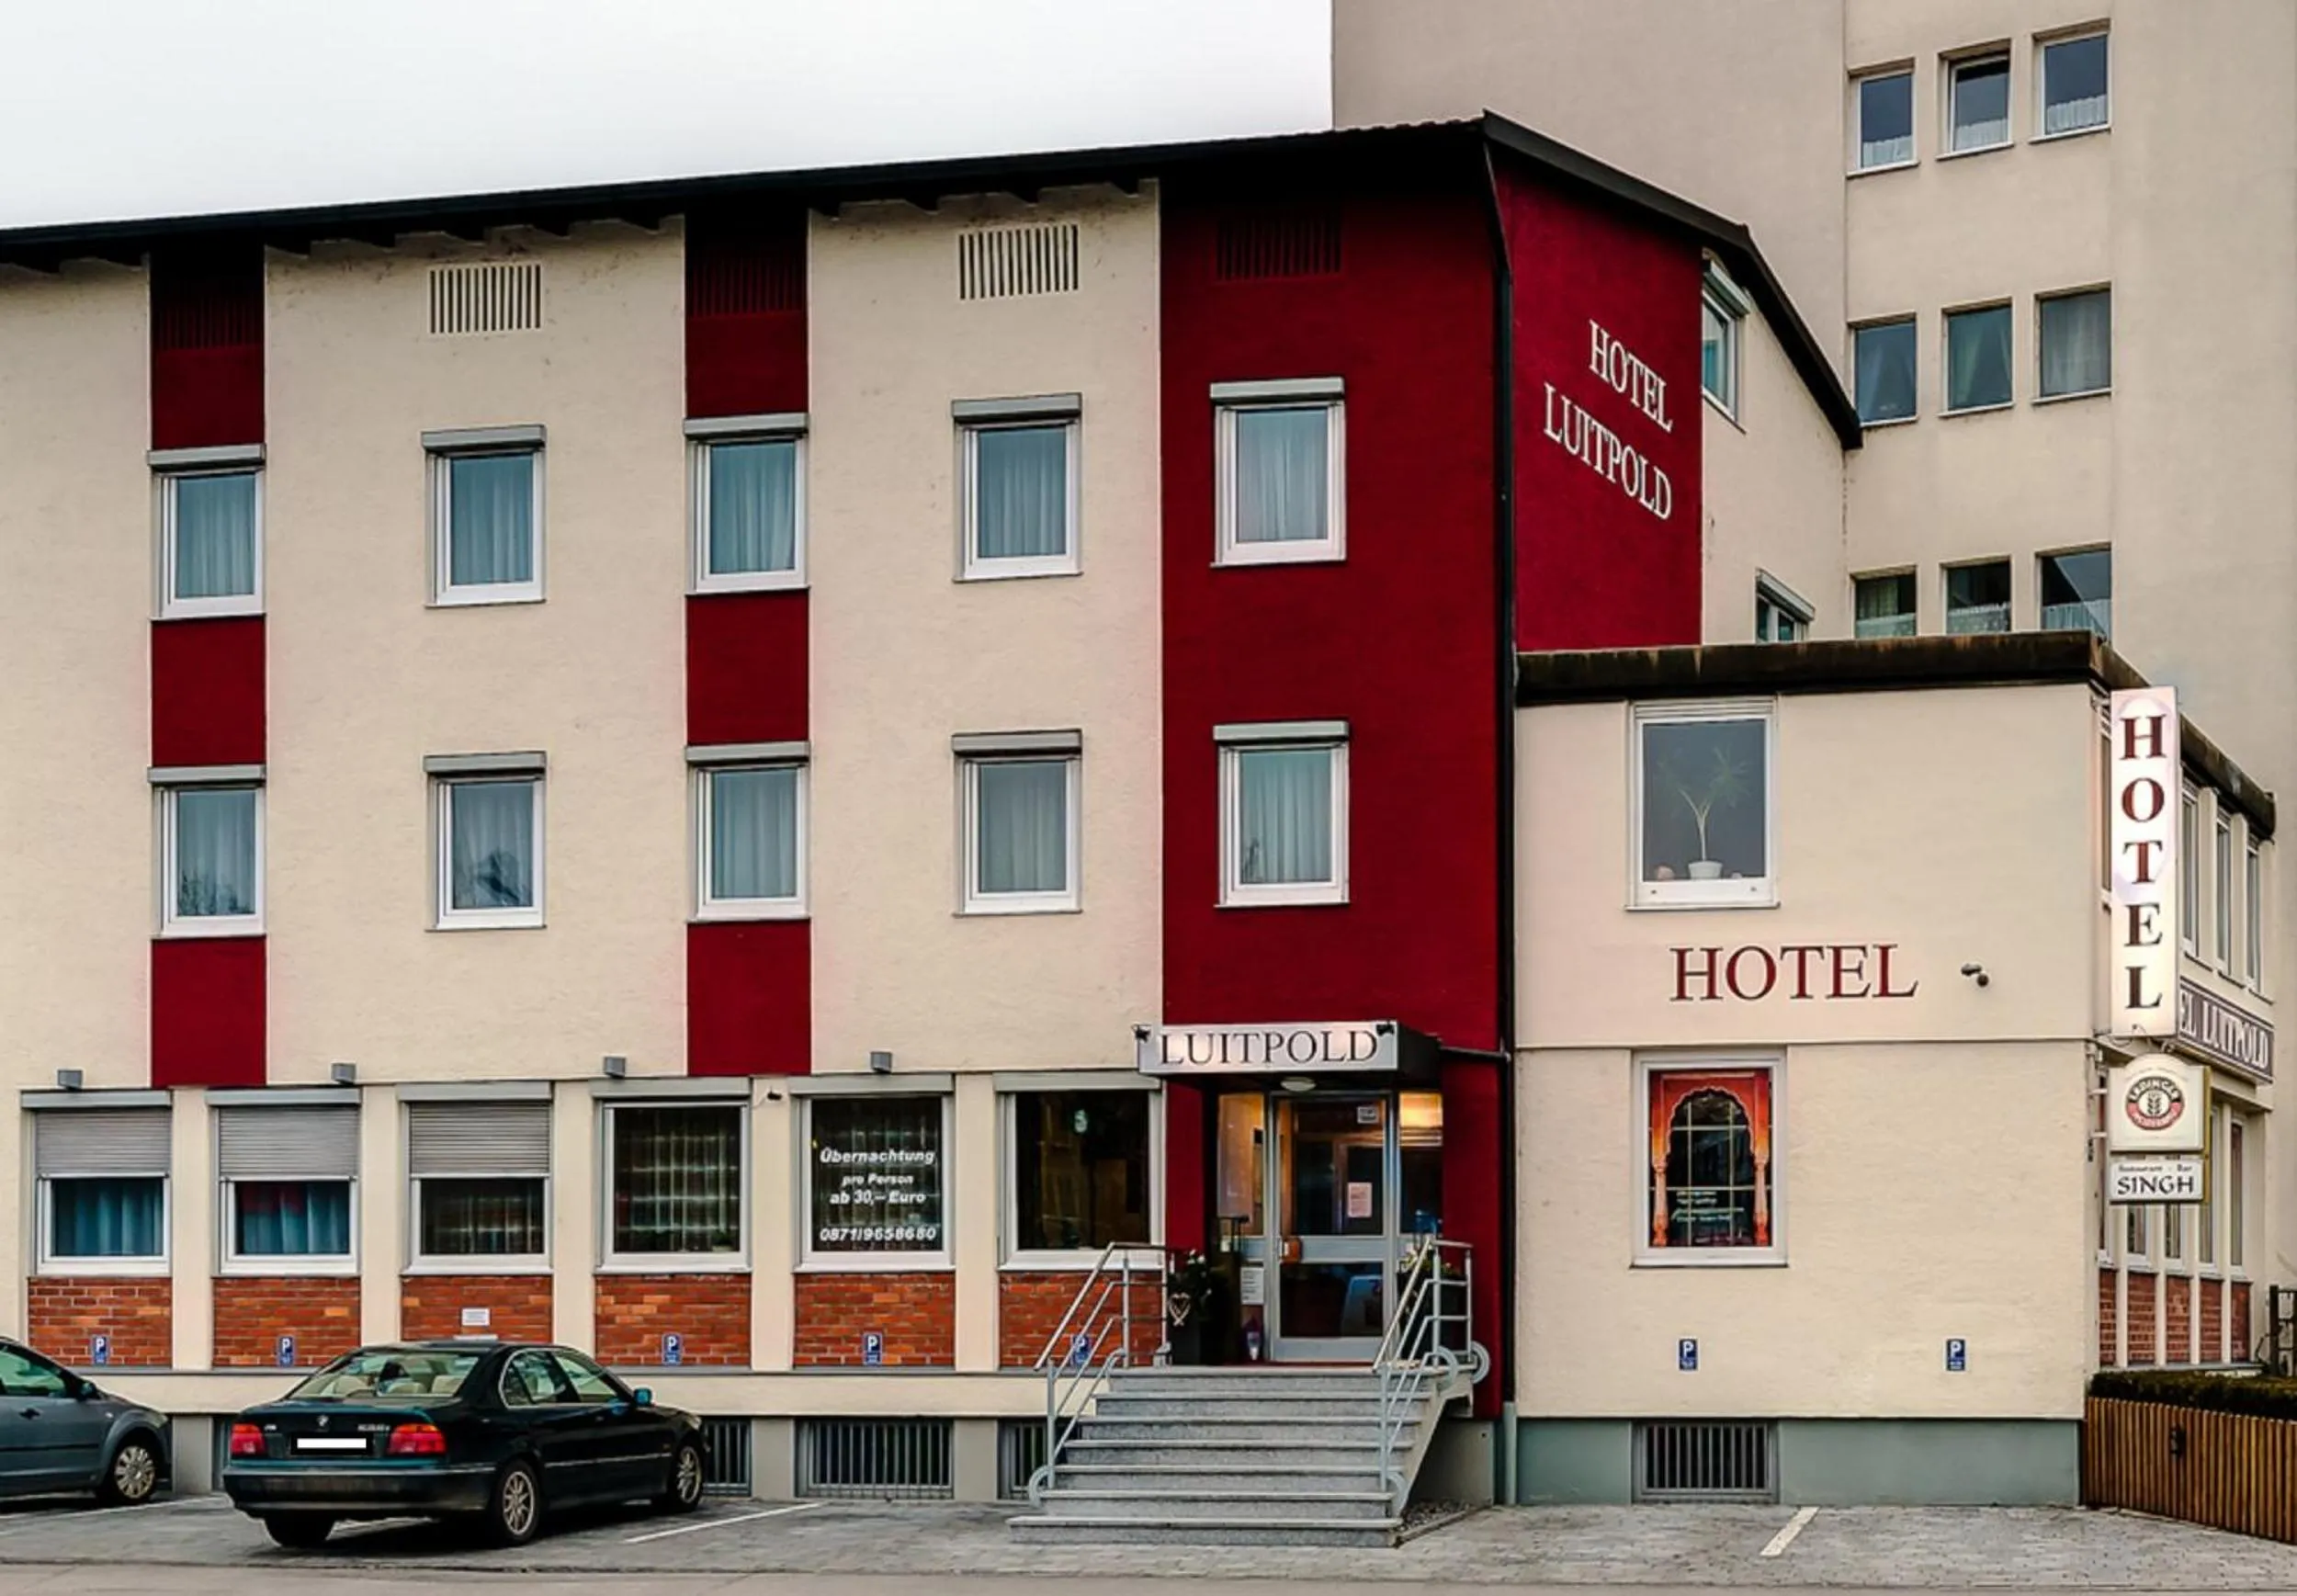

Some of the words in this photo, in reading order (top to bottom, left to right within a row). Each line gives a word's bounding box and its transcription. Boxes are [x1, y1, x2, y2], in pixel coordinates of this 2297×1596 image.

[1589, 319, 1673, 434] HOTEL
[1544, 382, 1672, 520] LUITPOLD
[2120, 714, 2167, 1009] HOTEL
[1669, 945, 1918, 1002] HOTEL
[2202, 1002, 2269, 1069] LUITPOLD
[1160, 1030, 1378, 1064] LUITPOLD
[820, 1147, 935, 1165] Übernachtung
[842, 1175, 865, 1187] pro
[867, 1172, 914, 1185] Person
[2118, 1175, 2194, 1195] SINGH
[830, 1190, 850, 1205] ab
[888, 1190, 926, 1205] Euro
[96, 1338, 105, 1353] P
[282, 1338, 291, 1353] P
[668, 1335, 676, 1352] P
[867, 1335, 877, 1352] P
[1683, 1341, 1693, 1356] P
[1951, 1341, 1962, 1356] P
